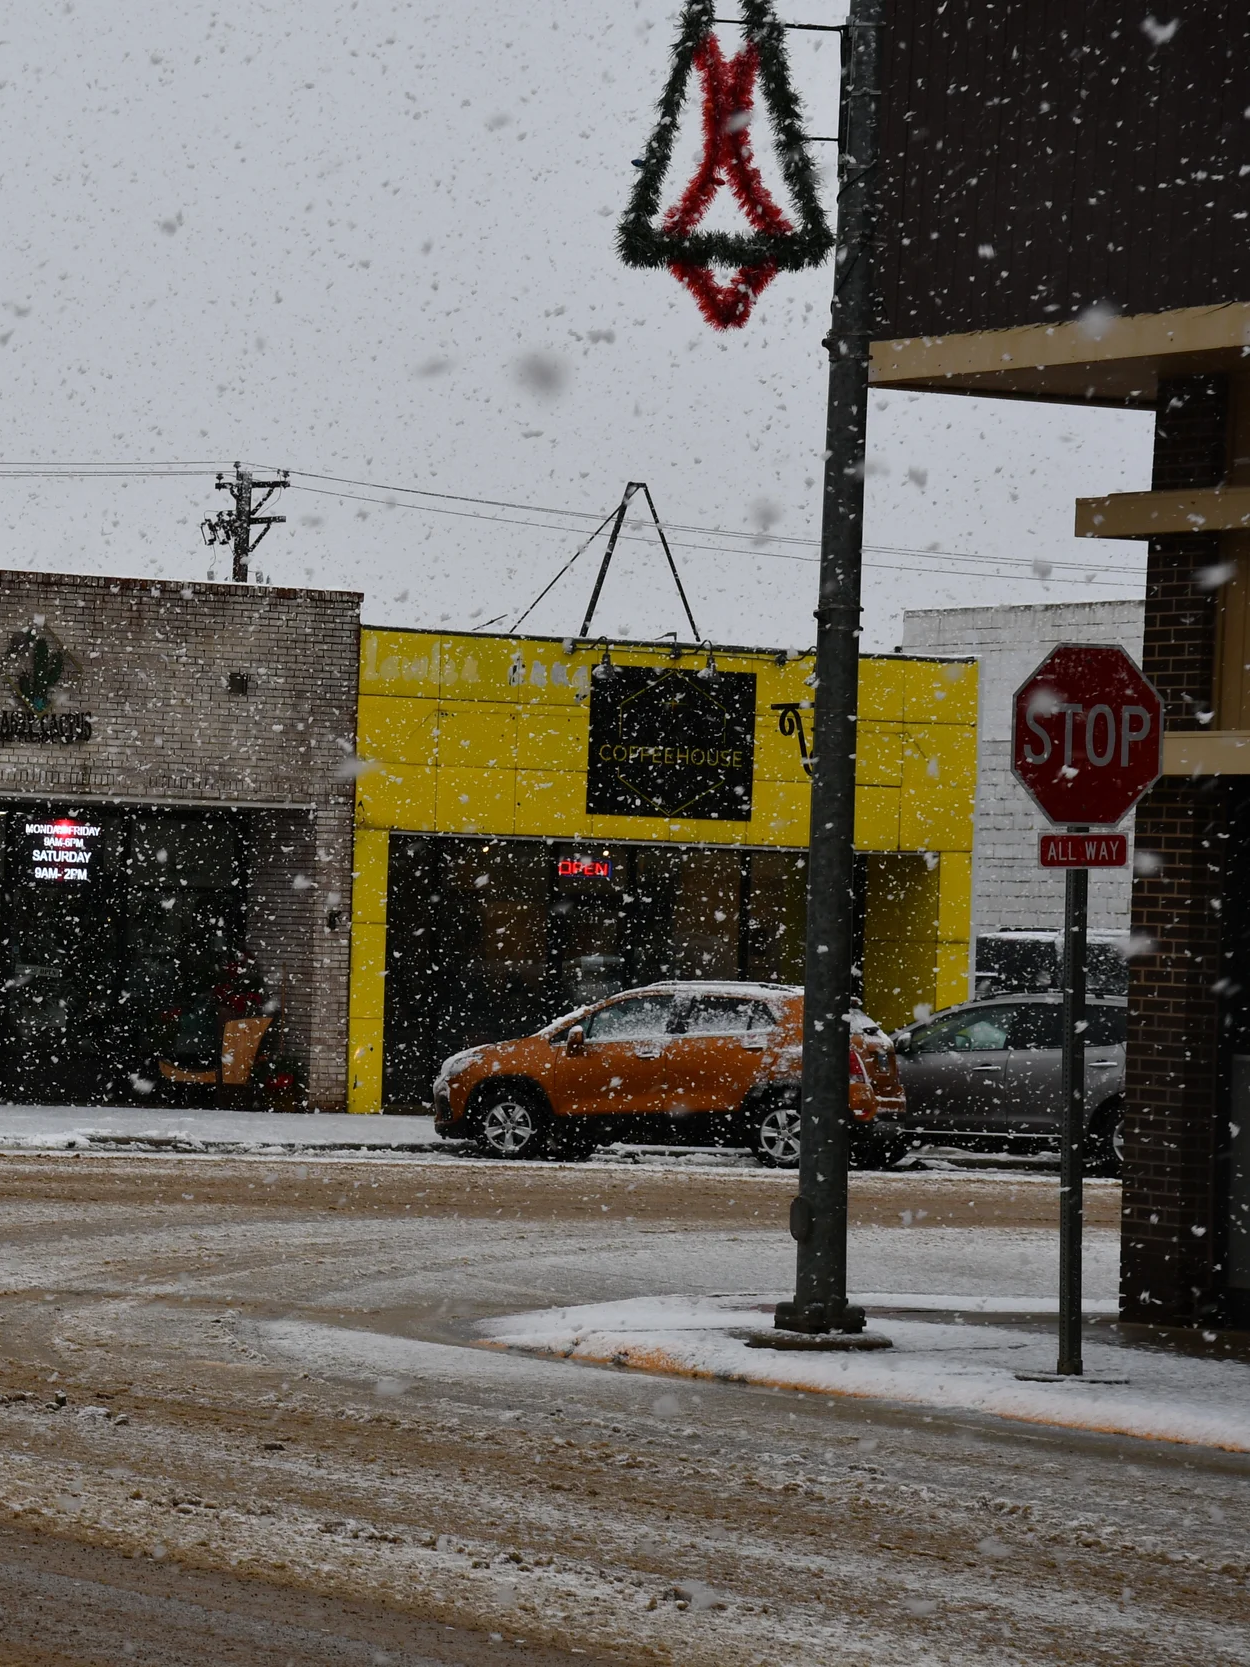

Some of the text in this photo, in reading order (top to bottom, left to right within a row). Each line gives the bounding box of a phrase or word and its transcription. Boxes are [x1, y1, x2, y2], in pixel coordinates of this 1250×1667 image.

[1023, 701, 1151, 767] STOP
[599, 744, 743, 768] COFFEEHOUSE
[32, 849, 92, 863] SATURDAY
[1047, 841, 1120, 861] ALL WAY
[558, 859, 609, 877] OPEN
